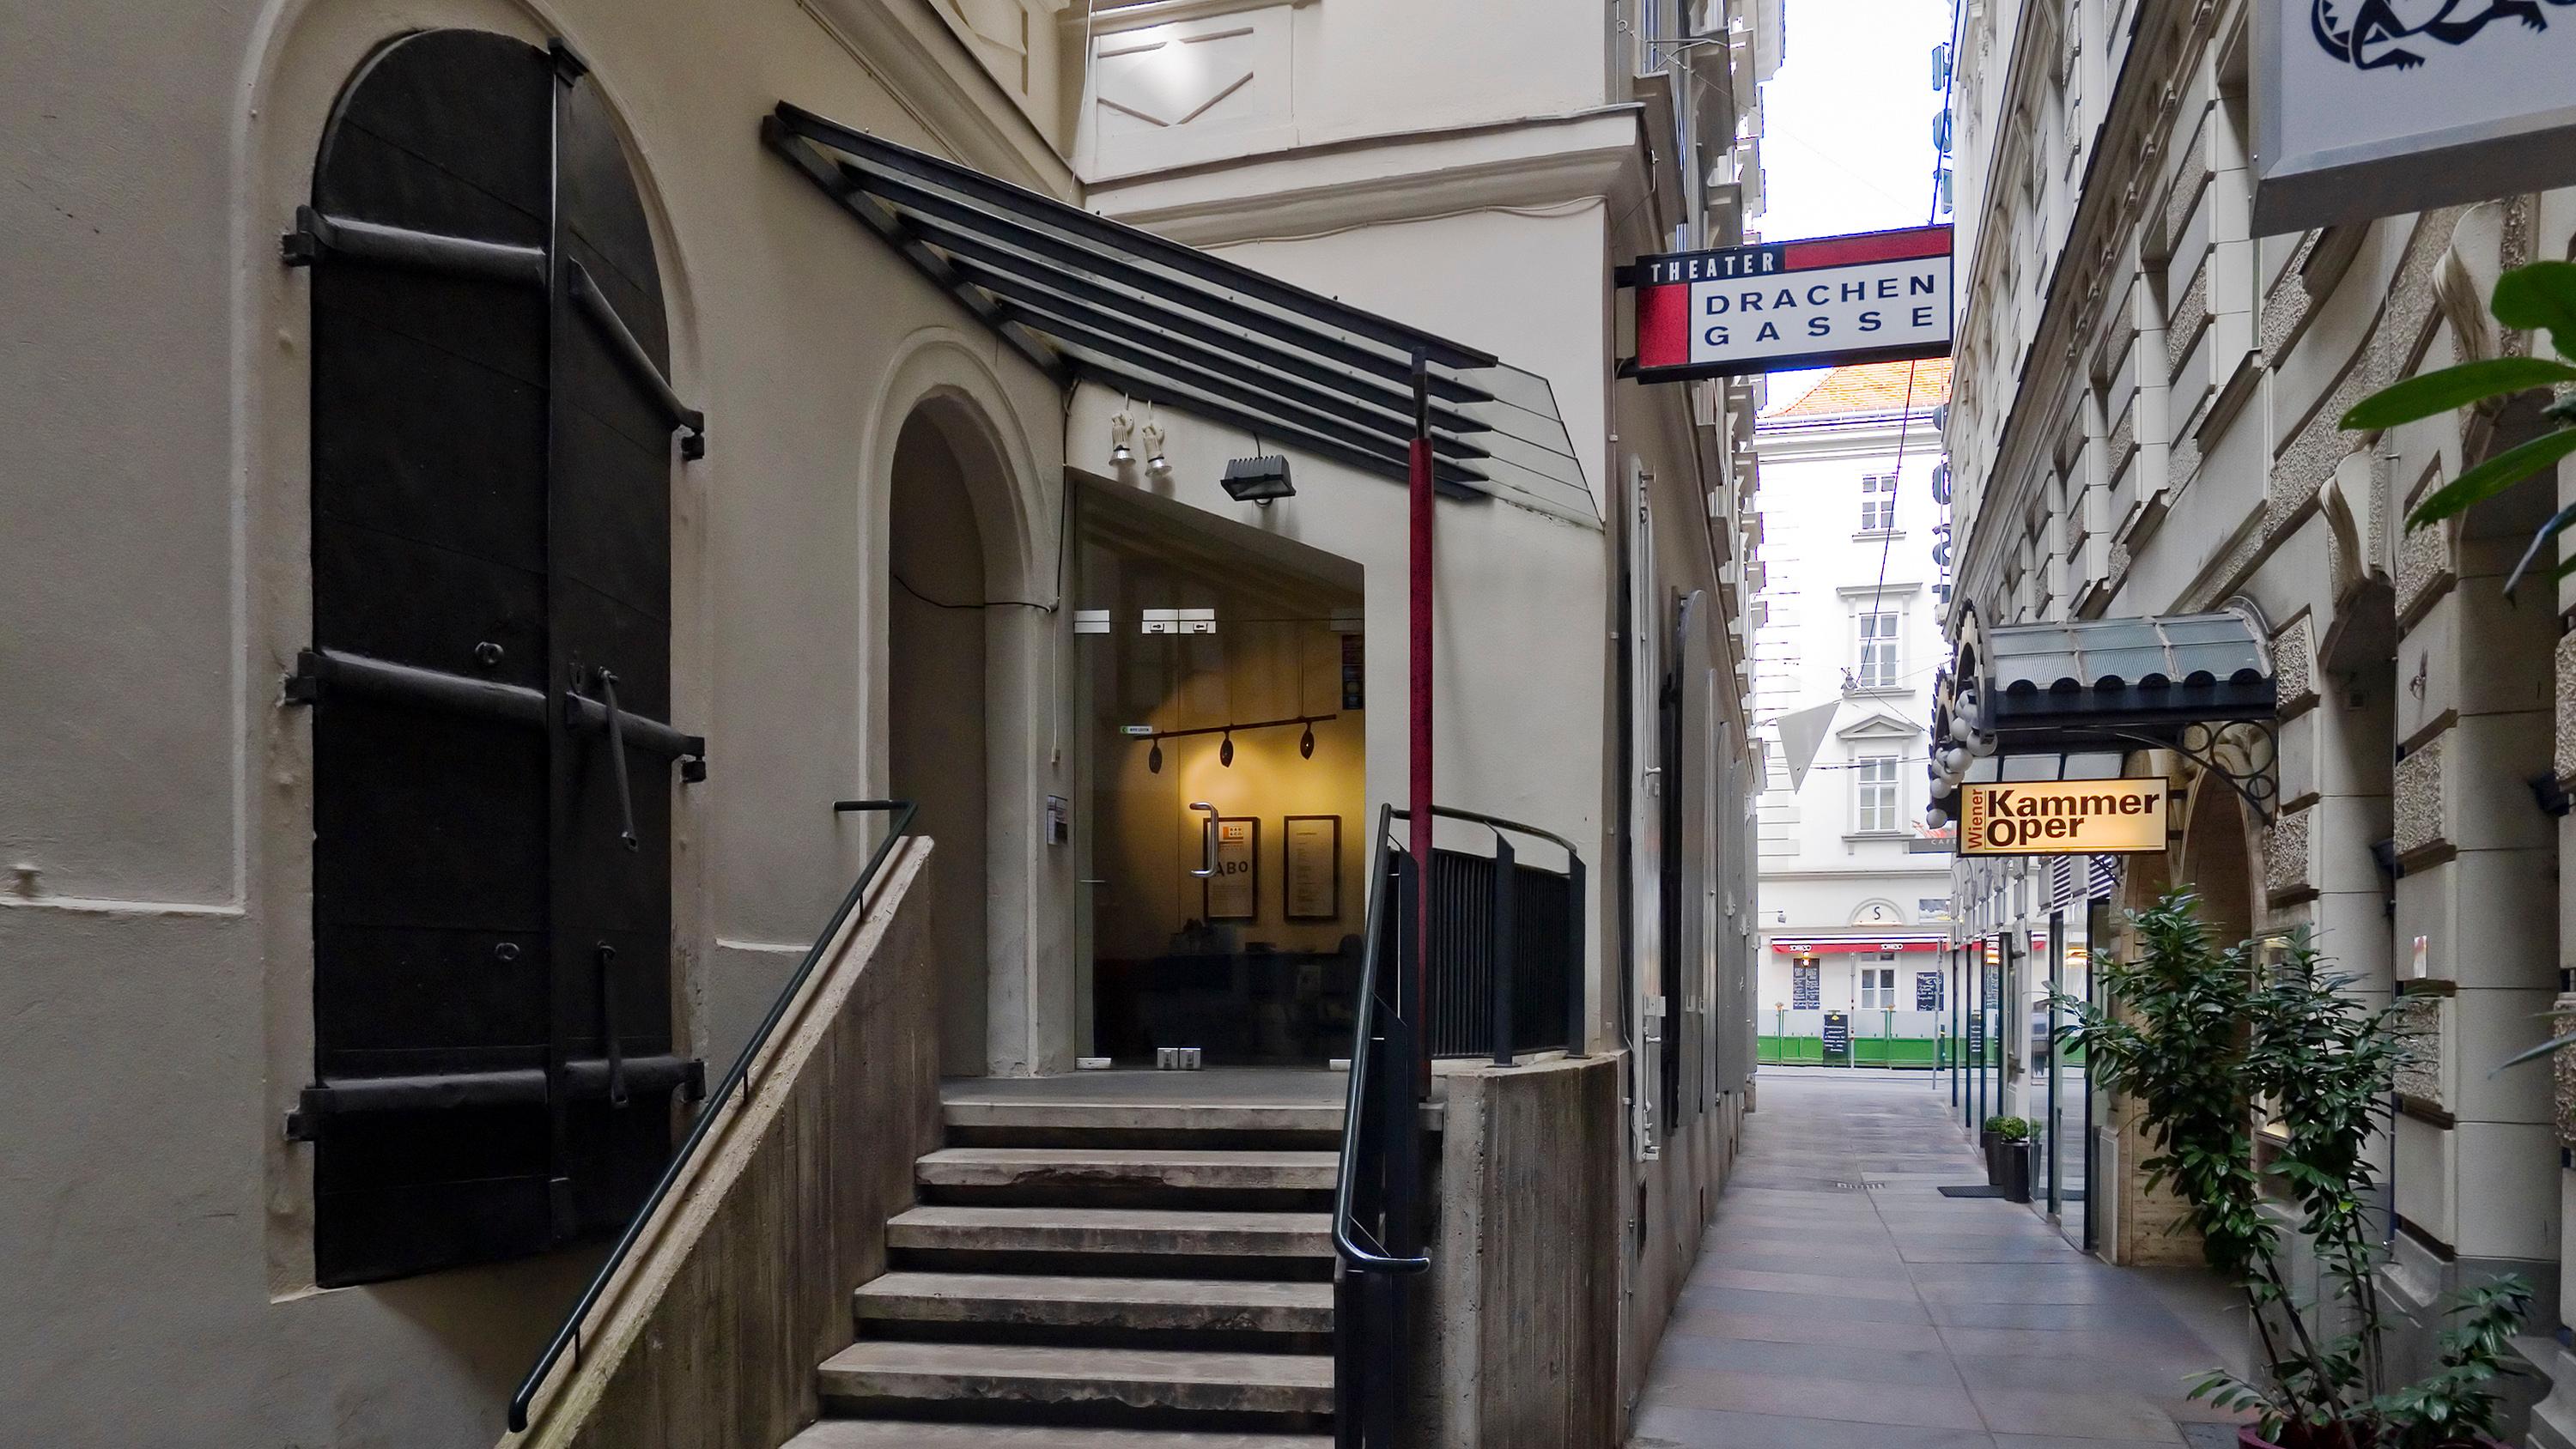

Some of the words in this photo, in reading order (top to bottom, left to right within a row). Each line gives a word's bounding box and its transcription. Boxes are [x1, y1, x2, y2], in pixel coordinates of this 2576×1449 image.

[1650, 252, 1775, 282] THEATER
[1705, 274, 1935, 316] DRACHEN
[1704, 306, 1934, 346] GASSE
[1988, 789, 2160, 817] Kammer
[1968, 789, 1983, 850] Wiener
[1987, 817, 2085, 846] Oper
[1215, 861, 1249, 876] ABO
[1874, 906, 1881, 920] S
